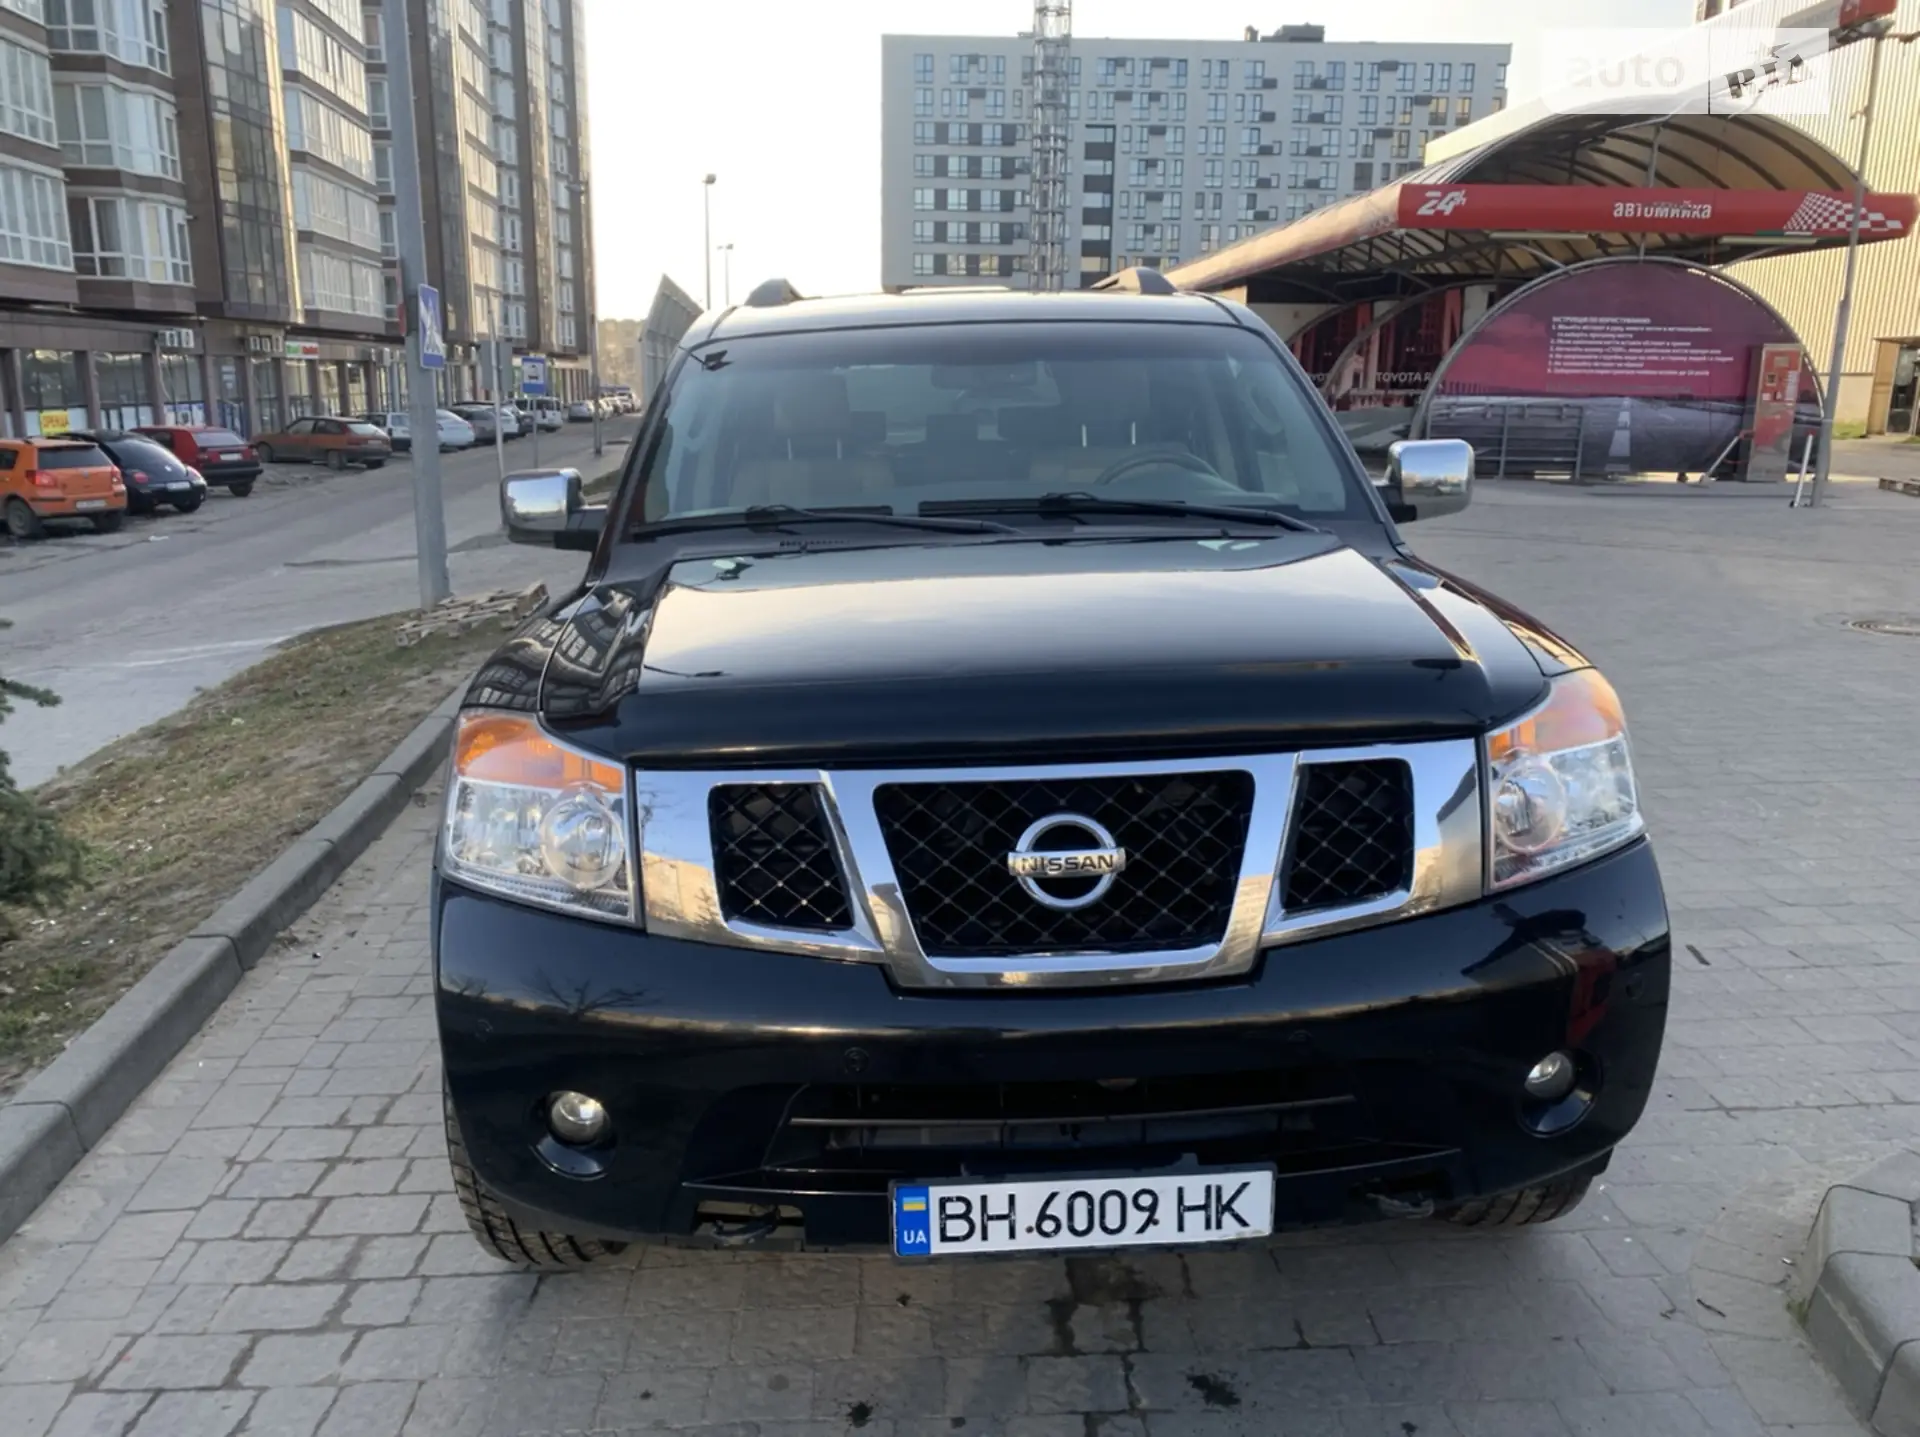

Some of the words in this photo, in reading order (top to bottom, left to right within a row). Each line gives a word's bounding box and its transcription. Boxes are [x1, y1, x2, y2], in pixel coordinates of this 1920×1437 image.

[1376, 371, 1422, 382] TOYOTA
[1021, 854, 1114, 871] NISSAN
[904, 1230, 927, 1244] UA
[938, 1193, 1016, 1243] BH
[1034, 1188, 1160, 1239] 6009
[1177, 1181, 1252, 1233] HK
